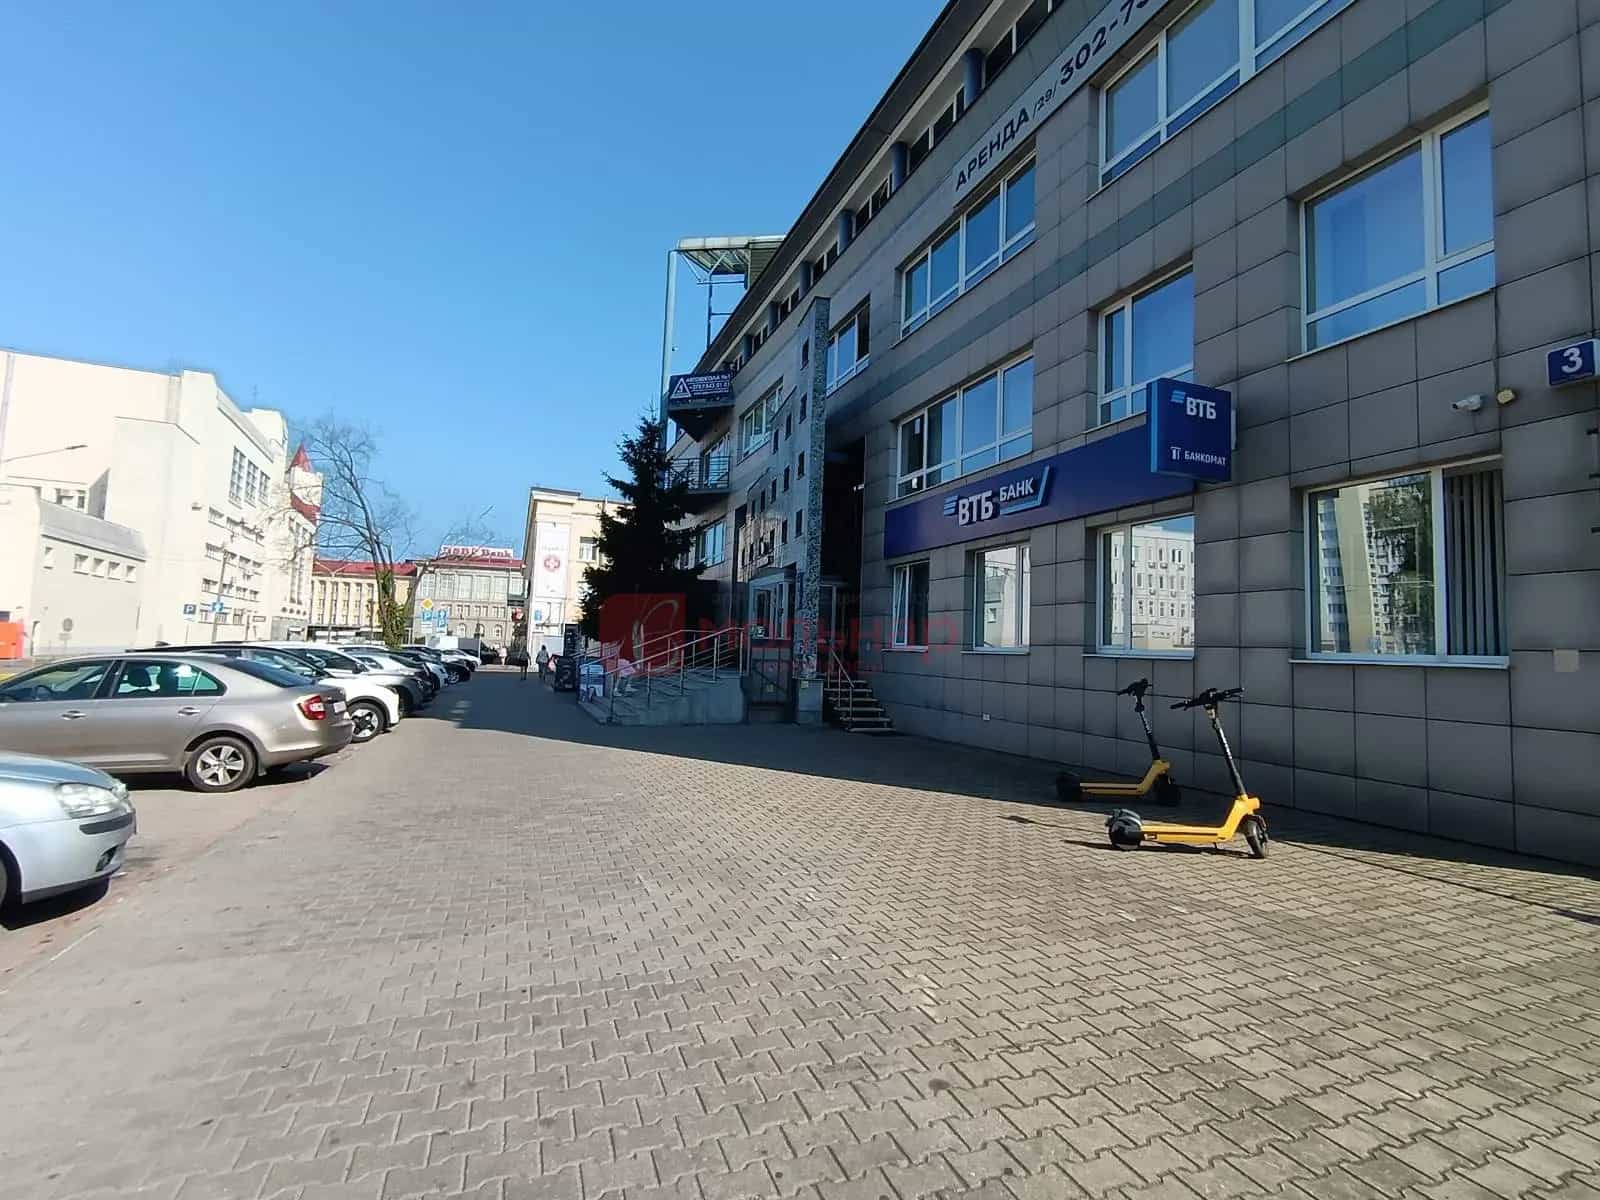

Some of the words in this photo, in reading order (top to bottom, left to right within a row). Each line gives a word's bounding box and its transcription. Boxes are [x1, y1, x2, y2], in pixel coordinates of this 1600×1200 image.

[956, 107, 1030, 191] АРЕНДА
[1561, 347, 1583, 374] 3
[1186, 396, 1217, 420] ВТБ
[1184, 449, 1226, 467] БАНКОМАТ
[958, 490, 994, 526] ВТБ
[999, 476, 1034, 503] БАНК
